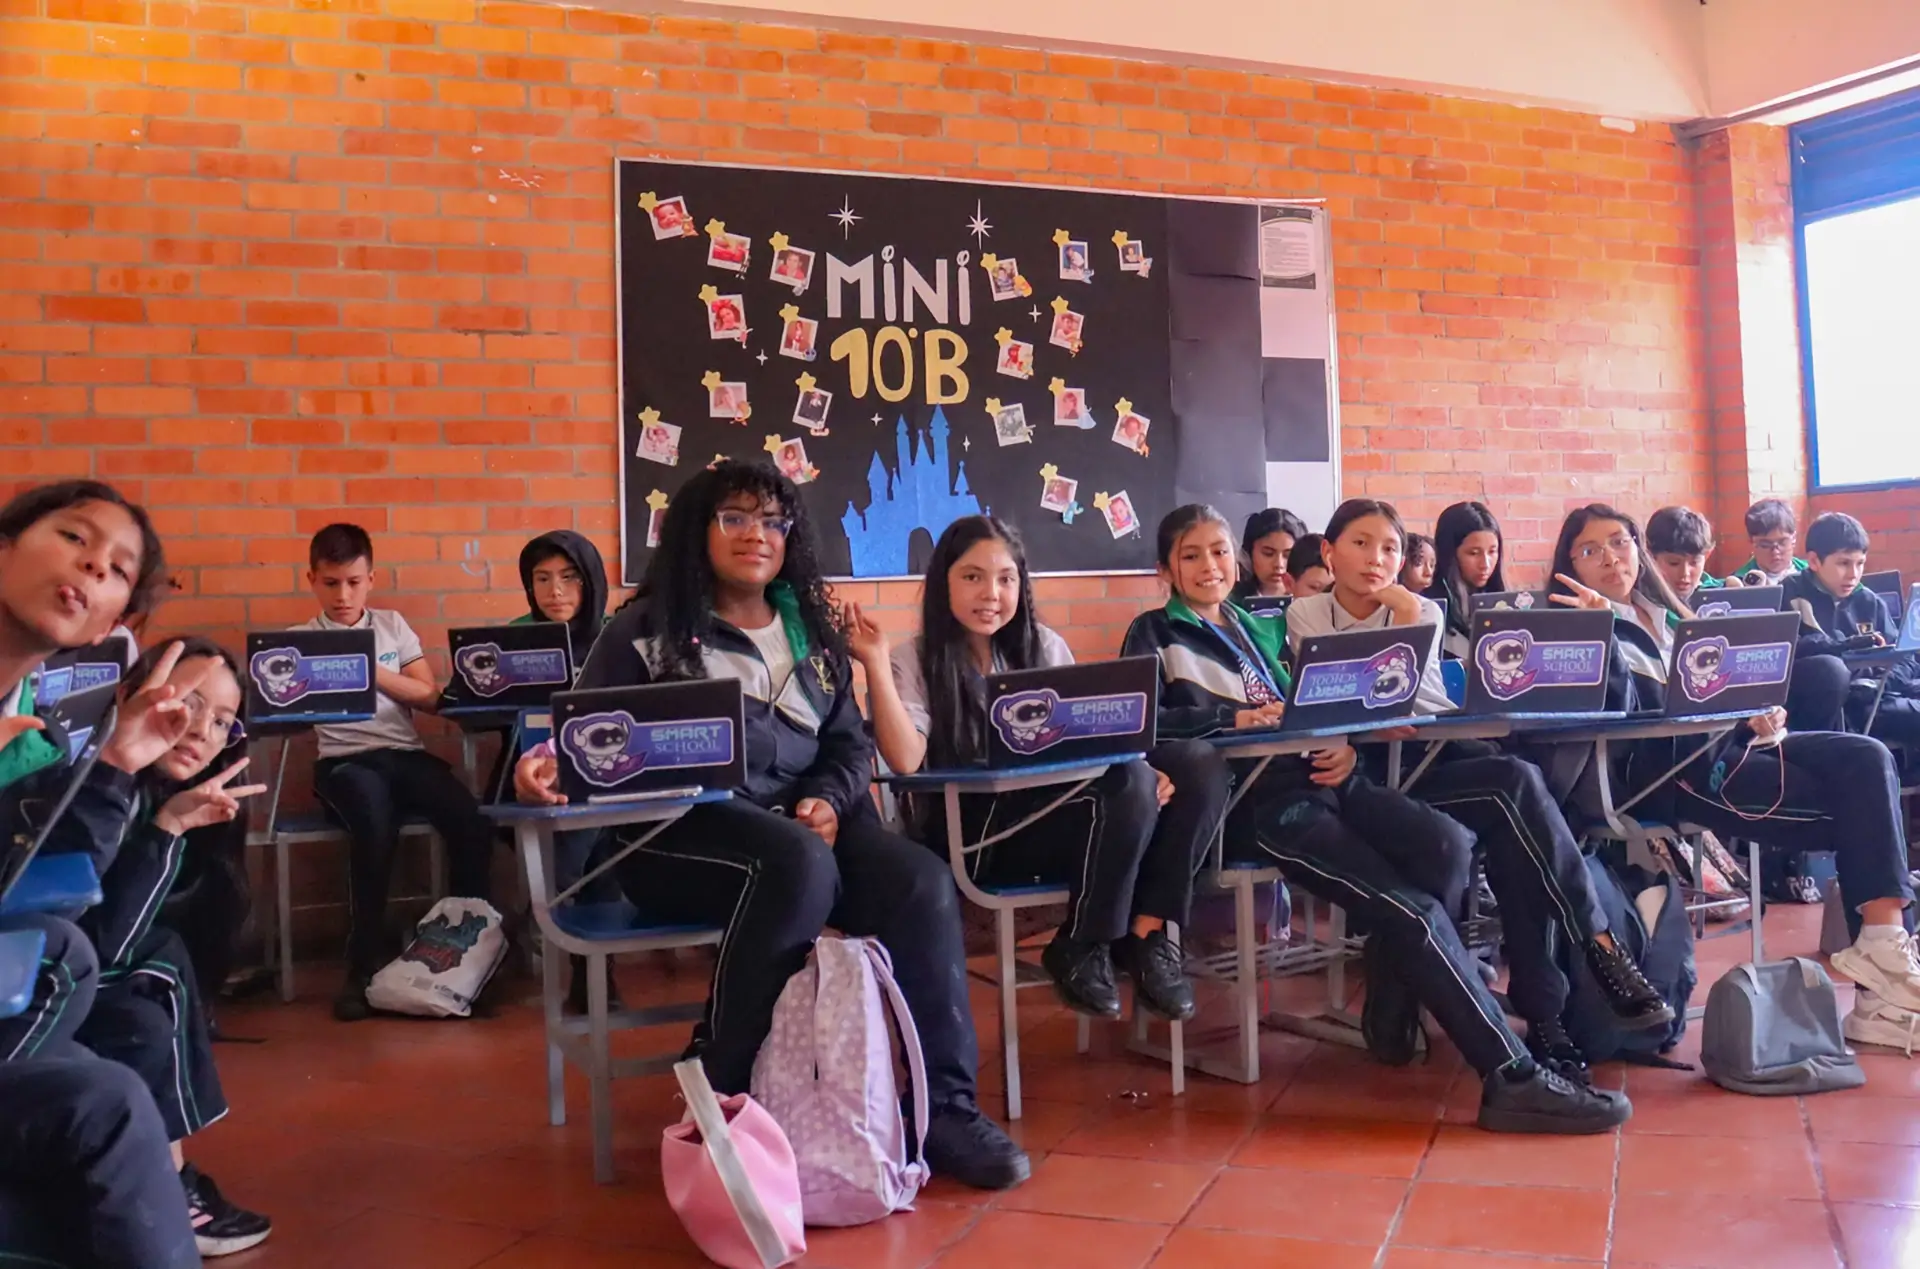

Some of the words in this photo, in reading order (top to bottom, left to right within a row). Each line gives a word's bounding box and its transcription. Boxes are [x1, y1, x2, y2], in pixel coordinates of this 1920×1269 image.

[510, 654, 557, 666] SMART
[1542, 646, 1596, 661] SMART
[1735, 648, 1784, 663] SMART
[311, 658, 360, 672] SMART
[1543, 659, 1593, 673] SCHOOL
[1734, 661, 1780, 674] SCHOOL
[313, 669, 360, 682] SCHOOL
[1309, 671, 1360, 687] SCHOOL
[1304, 682, 1358, 699] SMART
[1071, 699, 1136, 716] SMART
[1073, 711, 1135, 727] SCHOOL
[650, 725, 722, 743] SMART
[654, 739, 721, 755] SCHOOL
